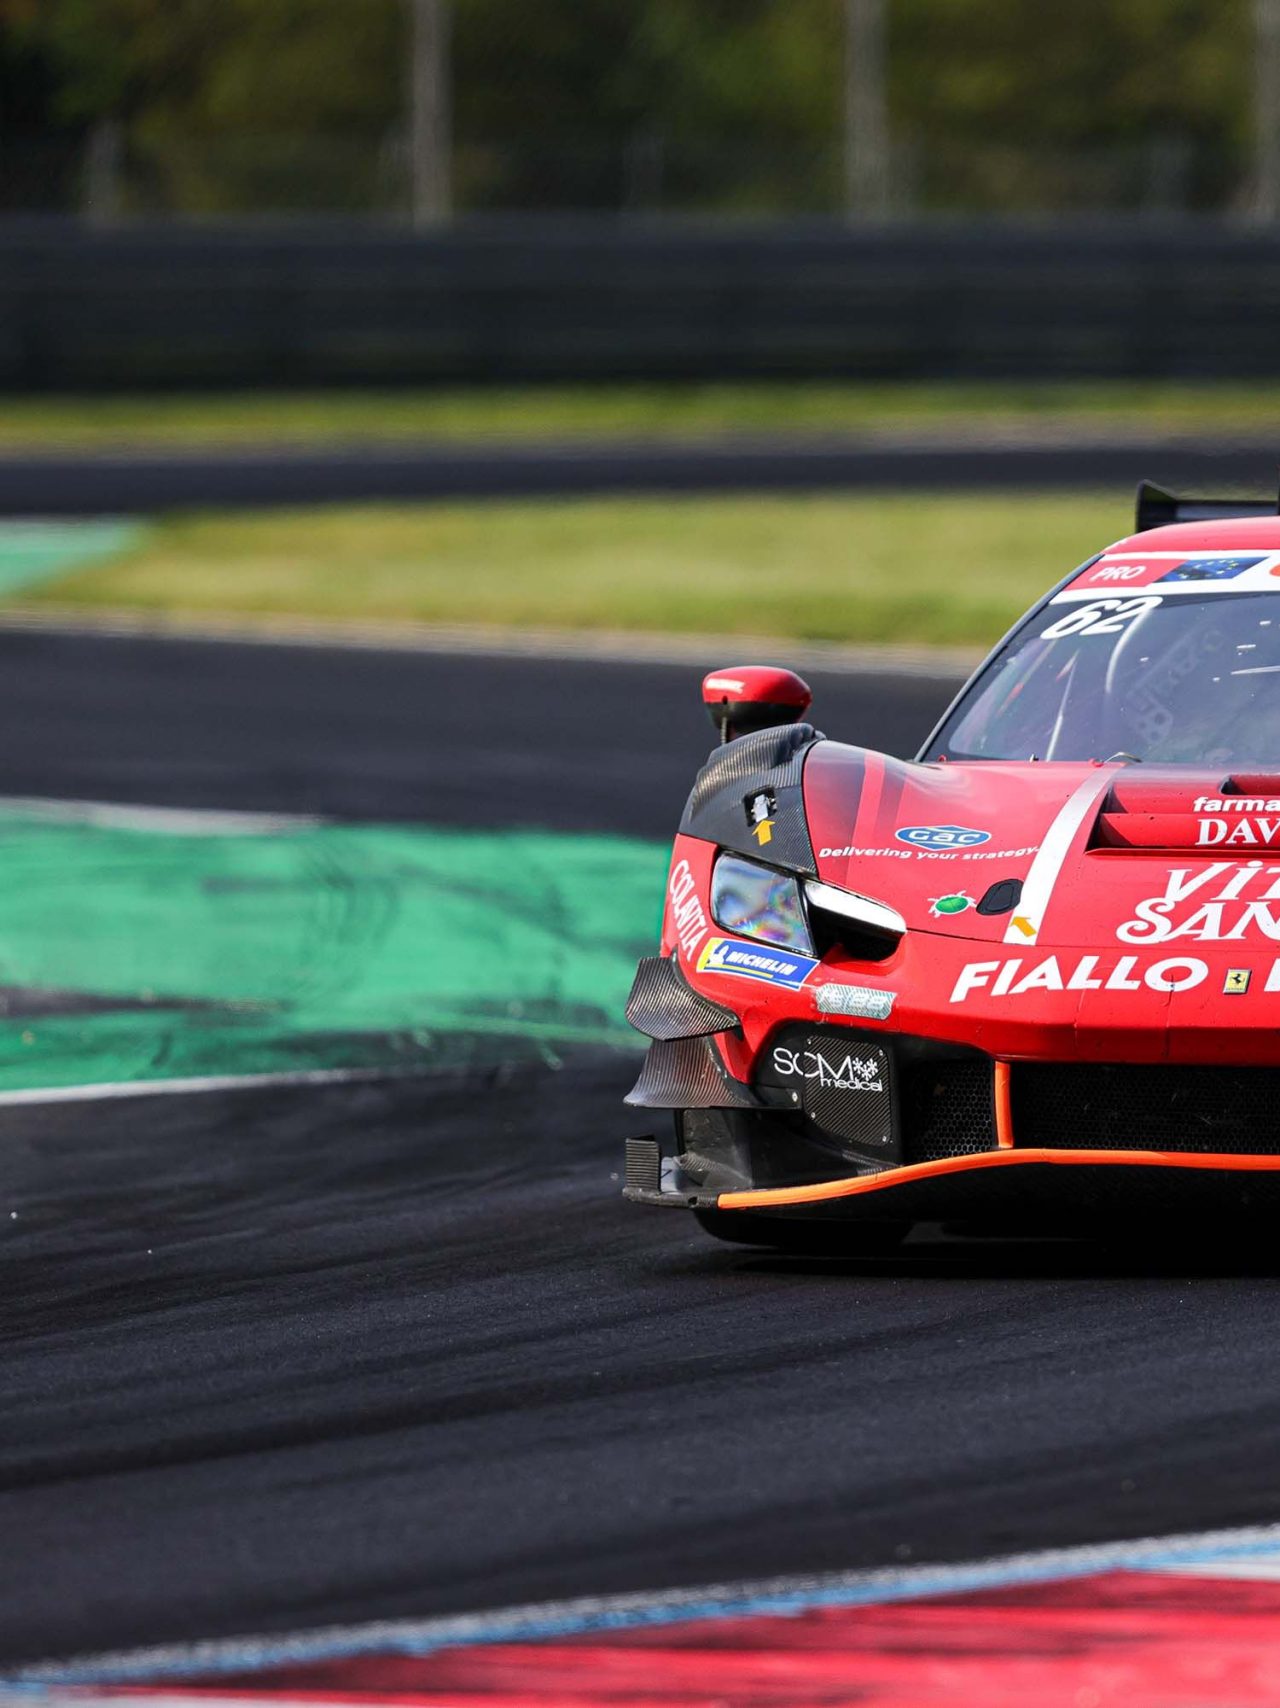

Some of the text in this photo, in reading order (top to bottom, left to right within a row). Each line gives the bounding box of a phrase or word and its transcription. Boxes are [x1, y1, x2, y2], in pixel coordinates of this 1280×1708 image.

[1089, 565, 1147, 583] PRO
[1040, 596, 1163, 639] 62
[819, 847, 912, 859] Delivering
[917, 851, 959, 860] your
[670, 859, 709, 963] COLAVITA
[726, 951, 798, 976] MICHELIN
[949, 956, 1209, 1003] FIALLO
[773, 1047, 854, 1080] SCM
[820, 1077, 883, 1092] medical
